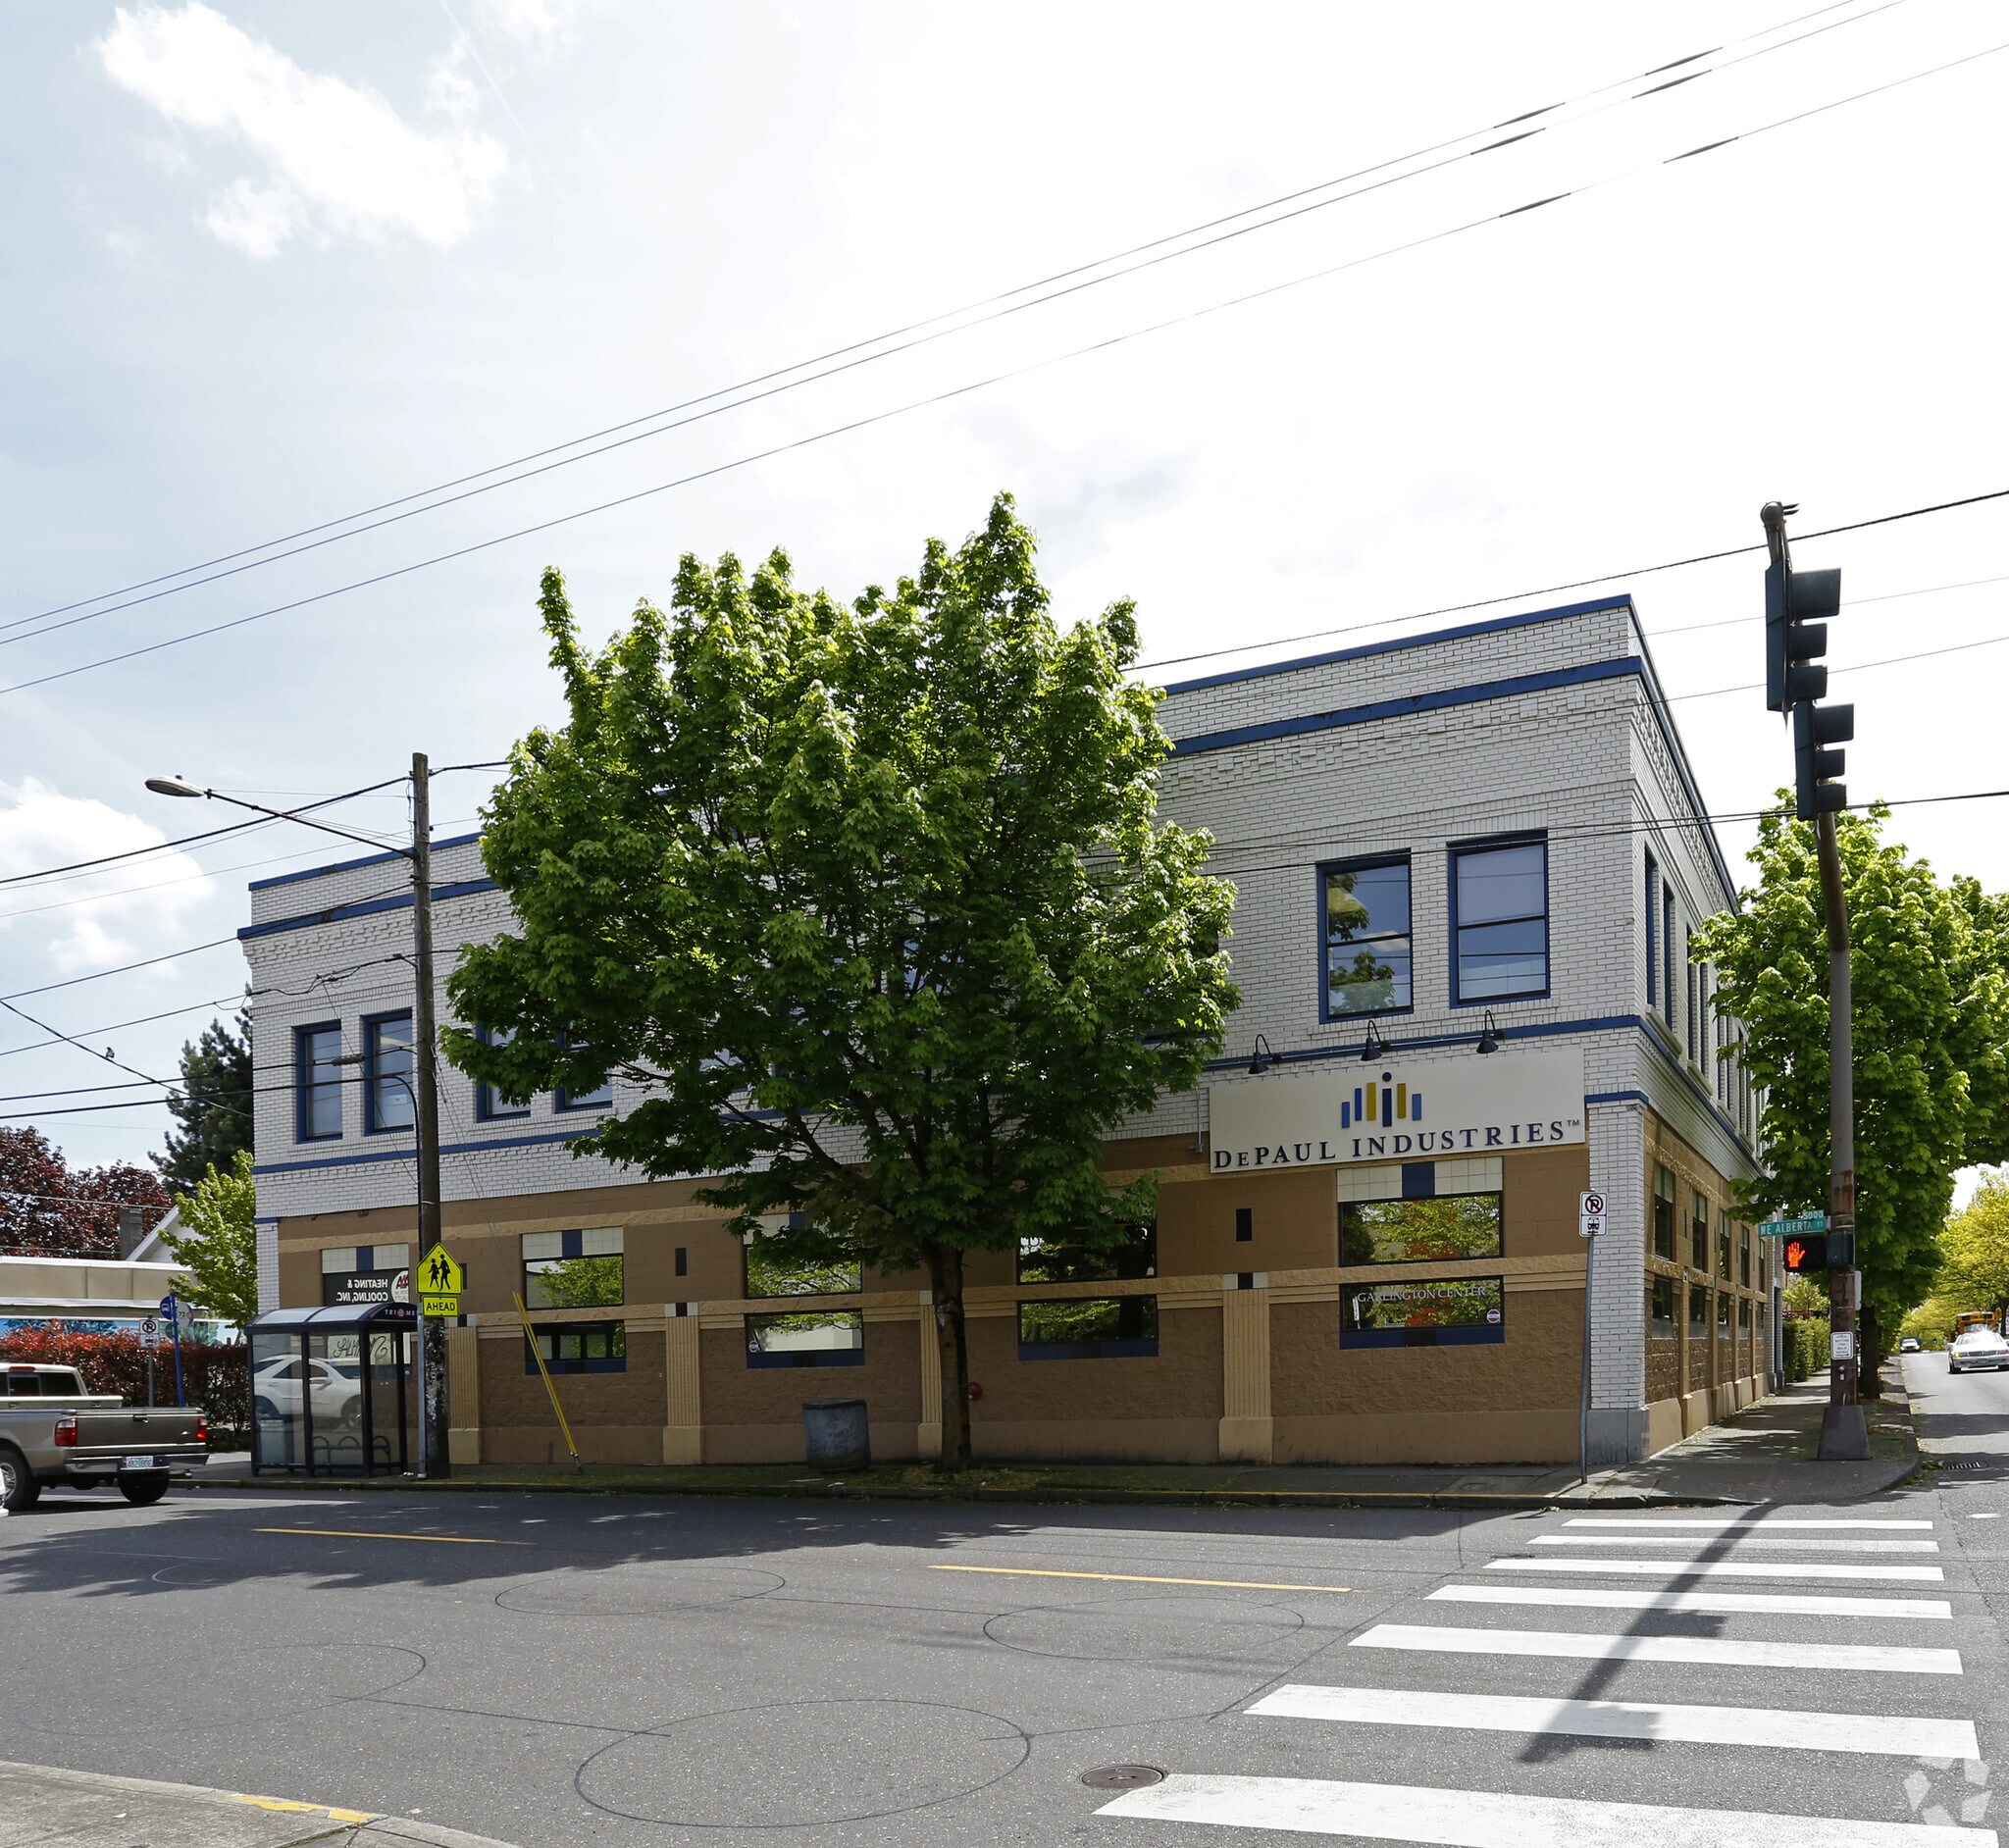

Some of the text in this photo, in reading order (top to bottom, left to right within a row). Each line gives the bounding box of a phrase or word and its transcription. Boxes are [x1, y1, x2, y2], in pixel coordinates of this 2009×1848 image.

[1352, 1120, 1565, 1157] INDUSTRIES
[1803, 1210, 1824, 1219] 5000
[1760, 1224, 1772, 1235] NE
[1775, 1220, 1813, 1234] ALBERTA
[1357, 1286, 1487, 1303] GARLINGTON CENTER
[426, 1302, 456, 1311] AHEAD
